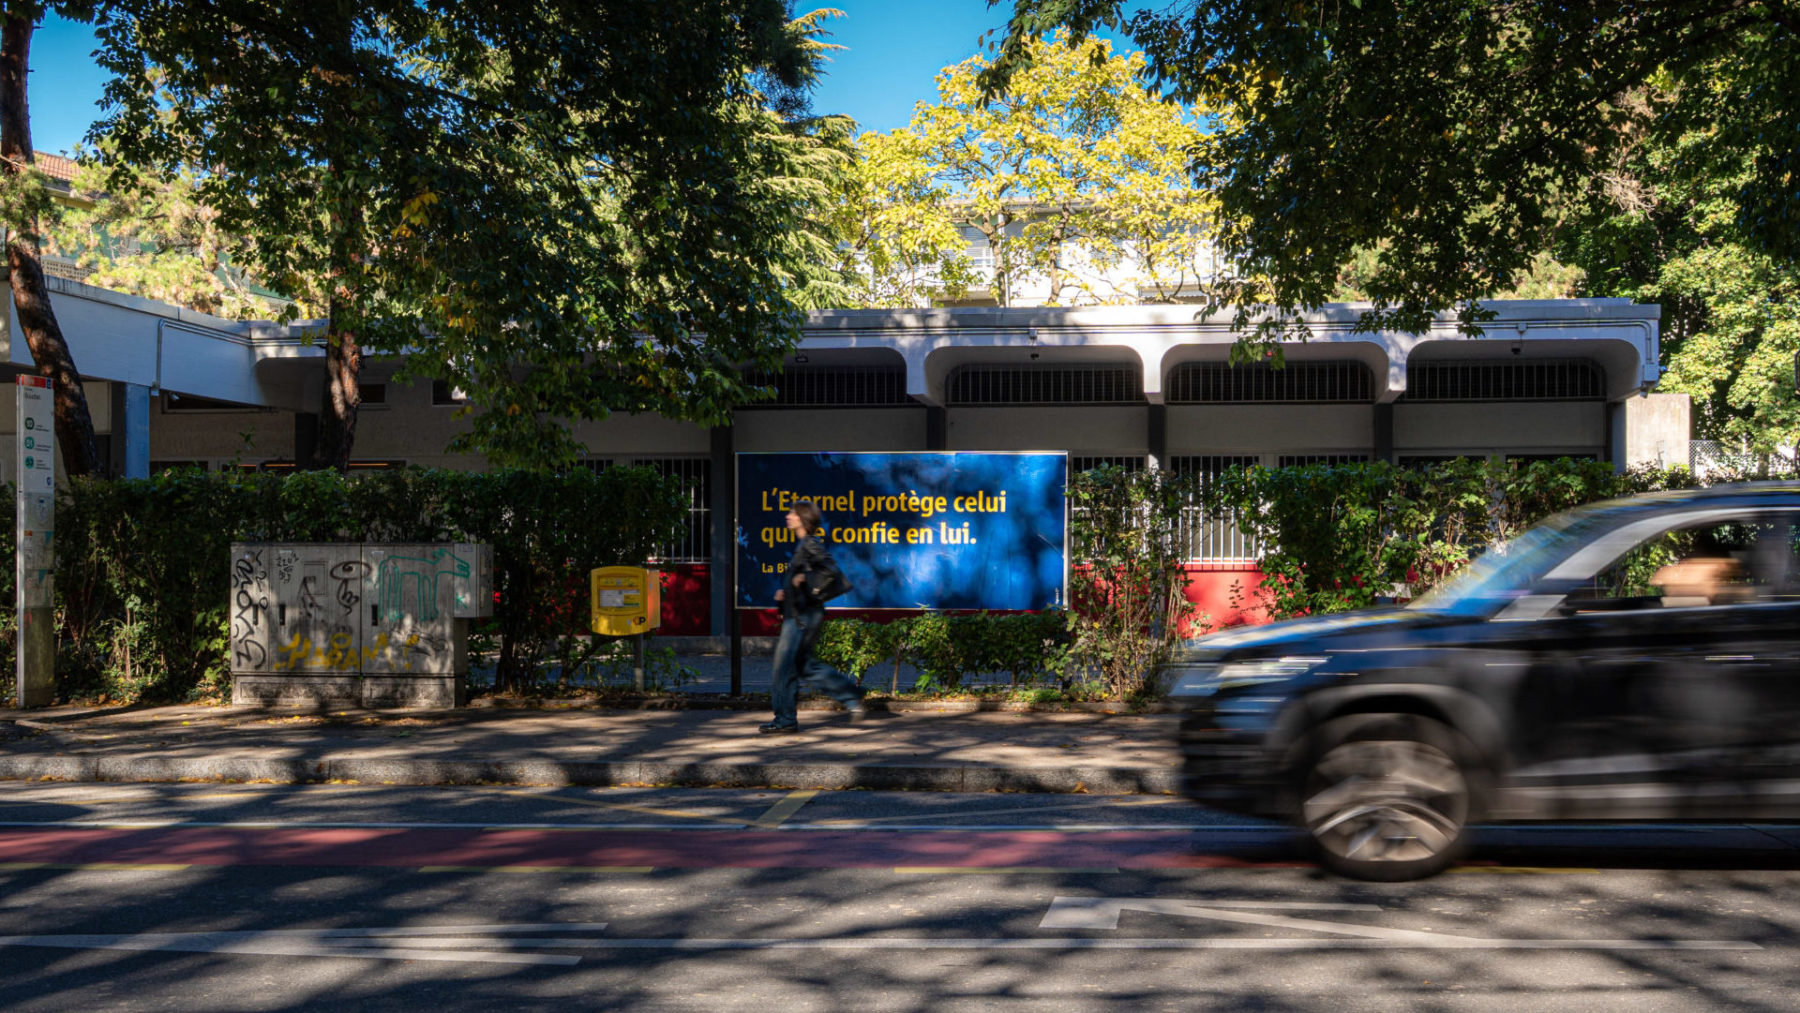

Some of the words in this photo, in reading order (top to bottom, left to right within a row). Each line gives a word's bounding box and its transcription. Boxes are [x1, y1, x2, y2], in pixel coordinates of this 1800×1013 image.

[863, 490, 948, 518] protège
[953, 490, 1007, 513] celui
[831, 521, 900, 544] confie
[906, 527, 933, 544] en
[940, 521, 977, 545] lui.
[762, 562, 774, 573] La
